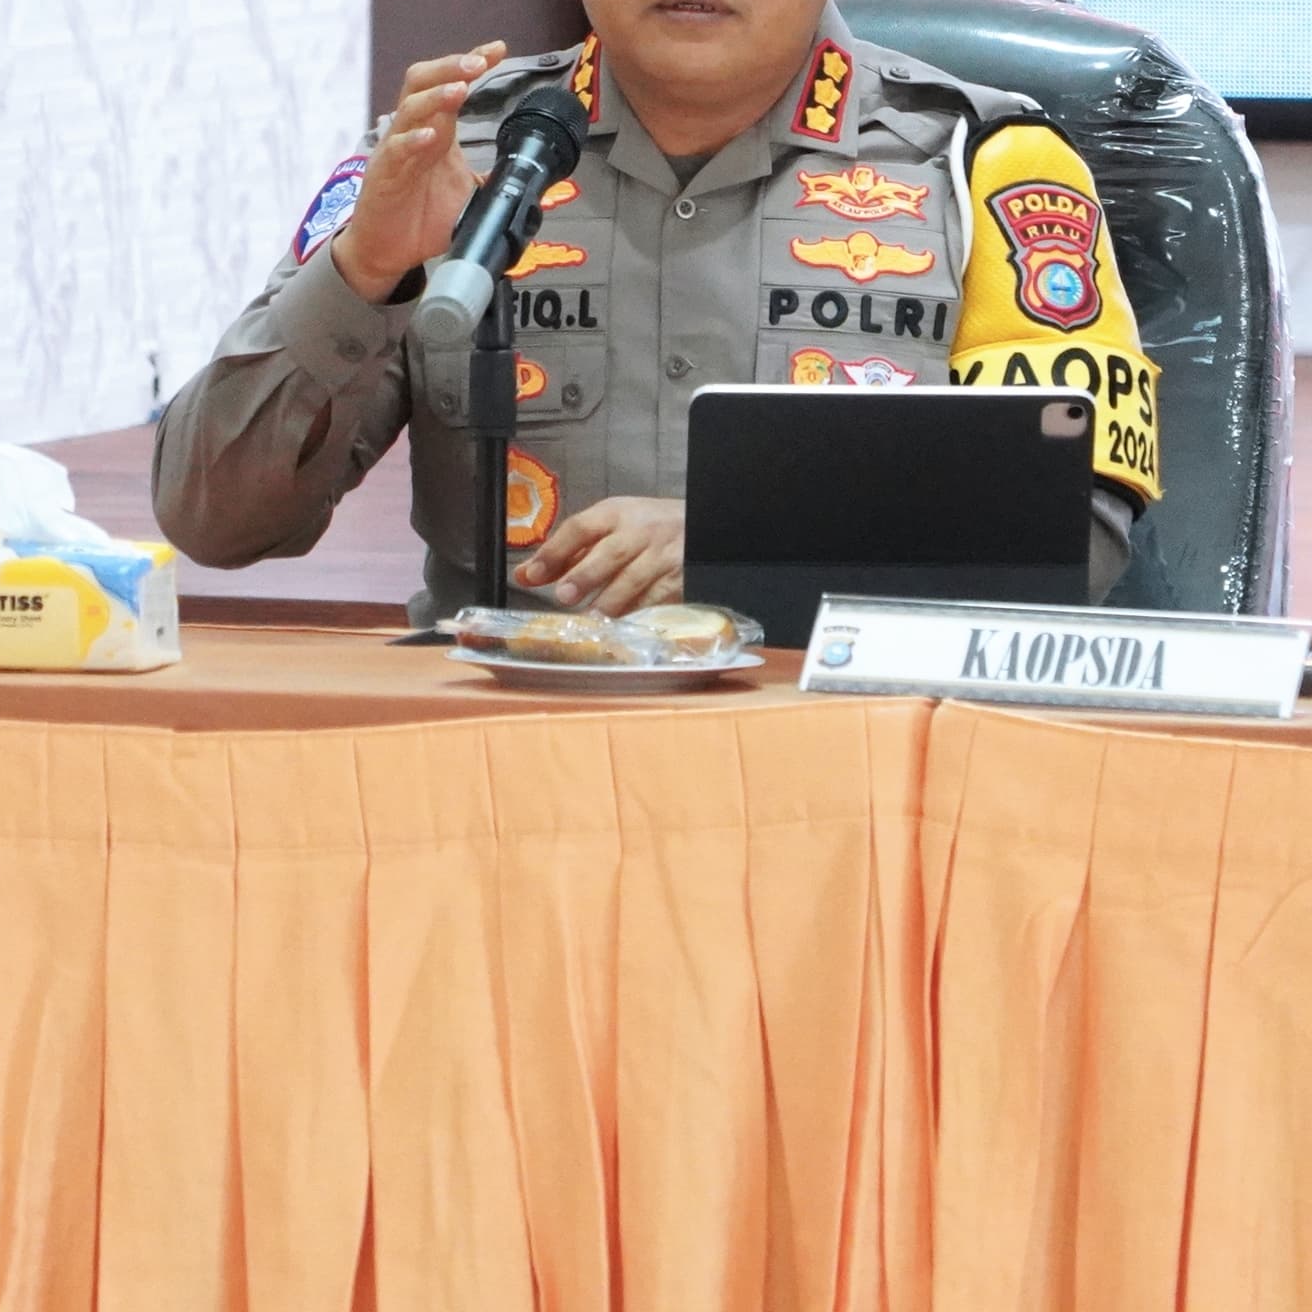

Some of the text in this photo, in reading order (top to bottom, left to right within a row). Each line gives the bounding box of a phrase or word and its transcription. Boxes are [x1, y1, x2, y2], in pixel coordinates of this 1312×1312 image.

[1007, 192, 1088, 224] POLDA
[1025, 223, 1080, 240] RIAU
[768, 288, 948, 341] POLRI
[958, 627, 1167, 690] KAOPSDA
